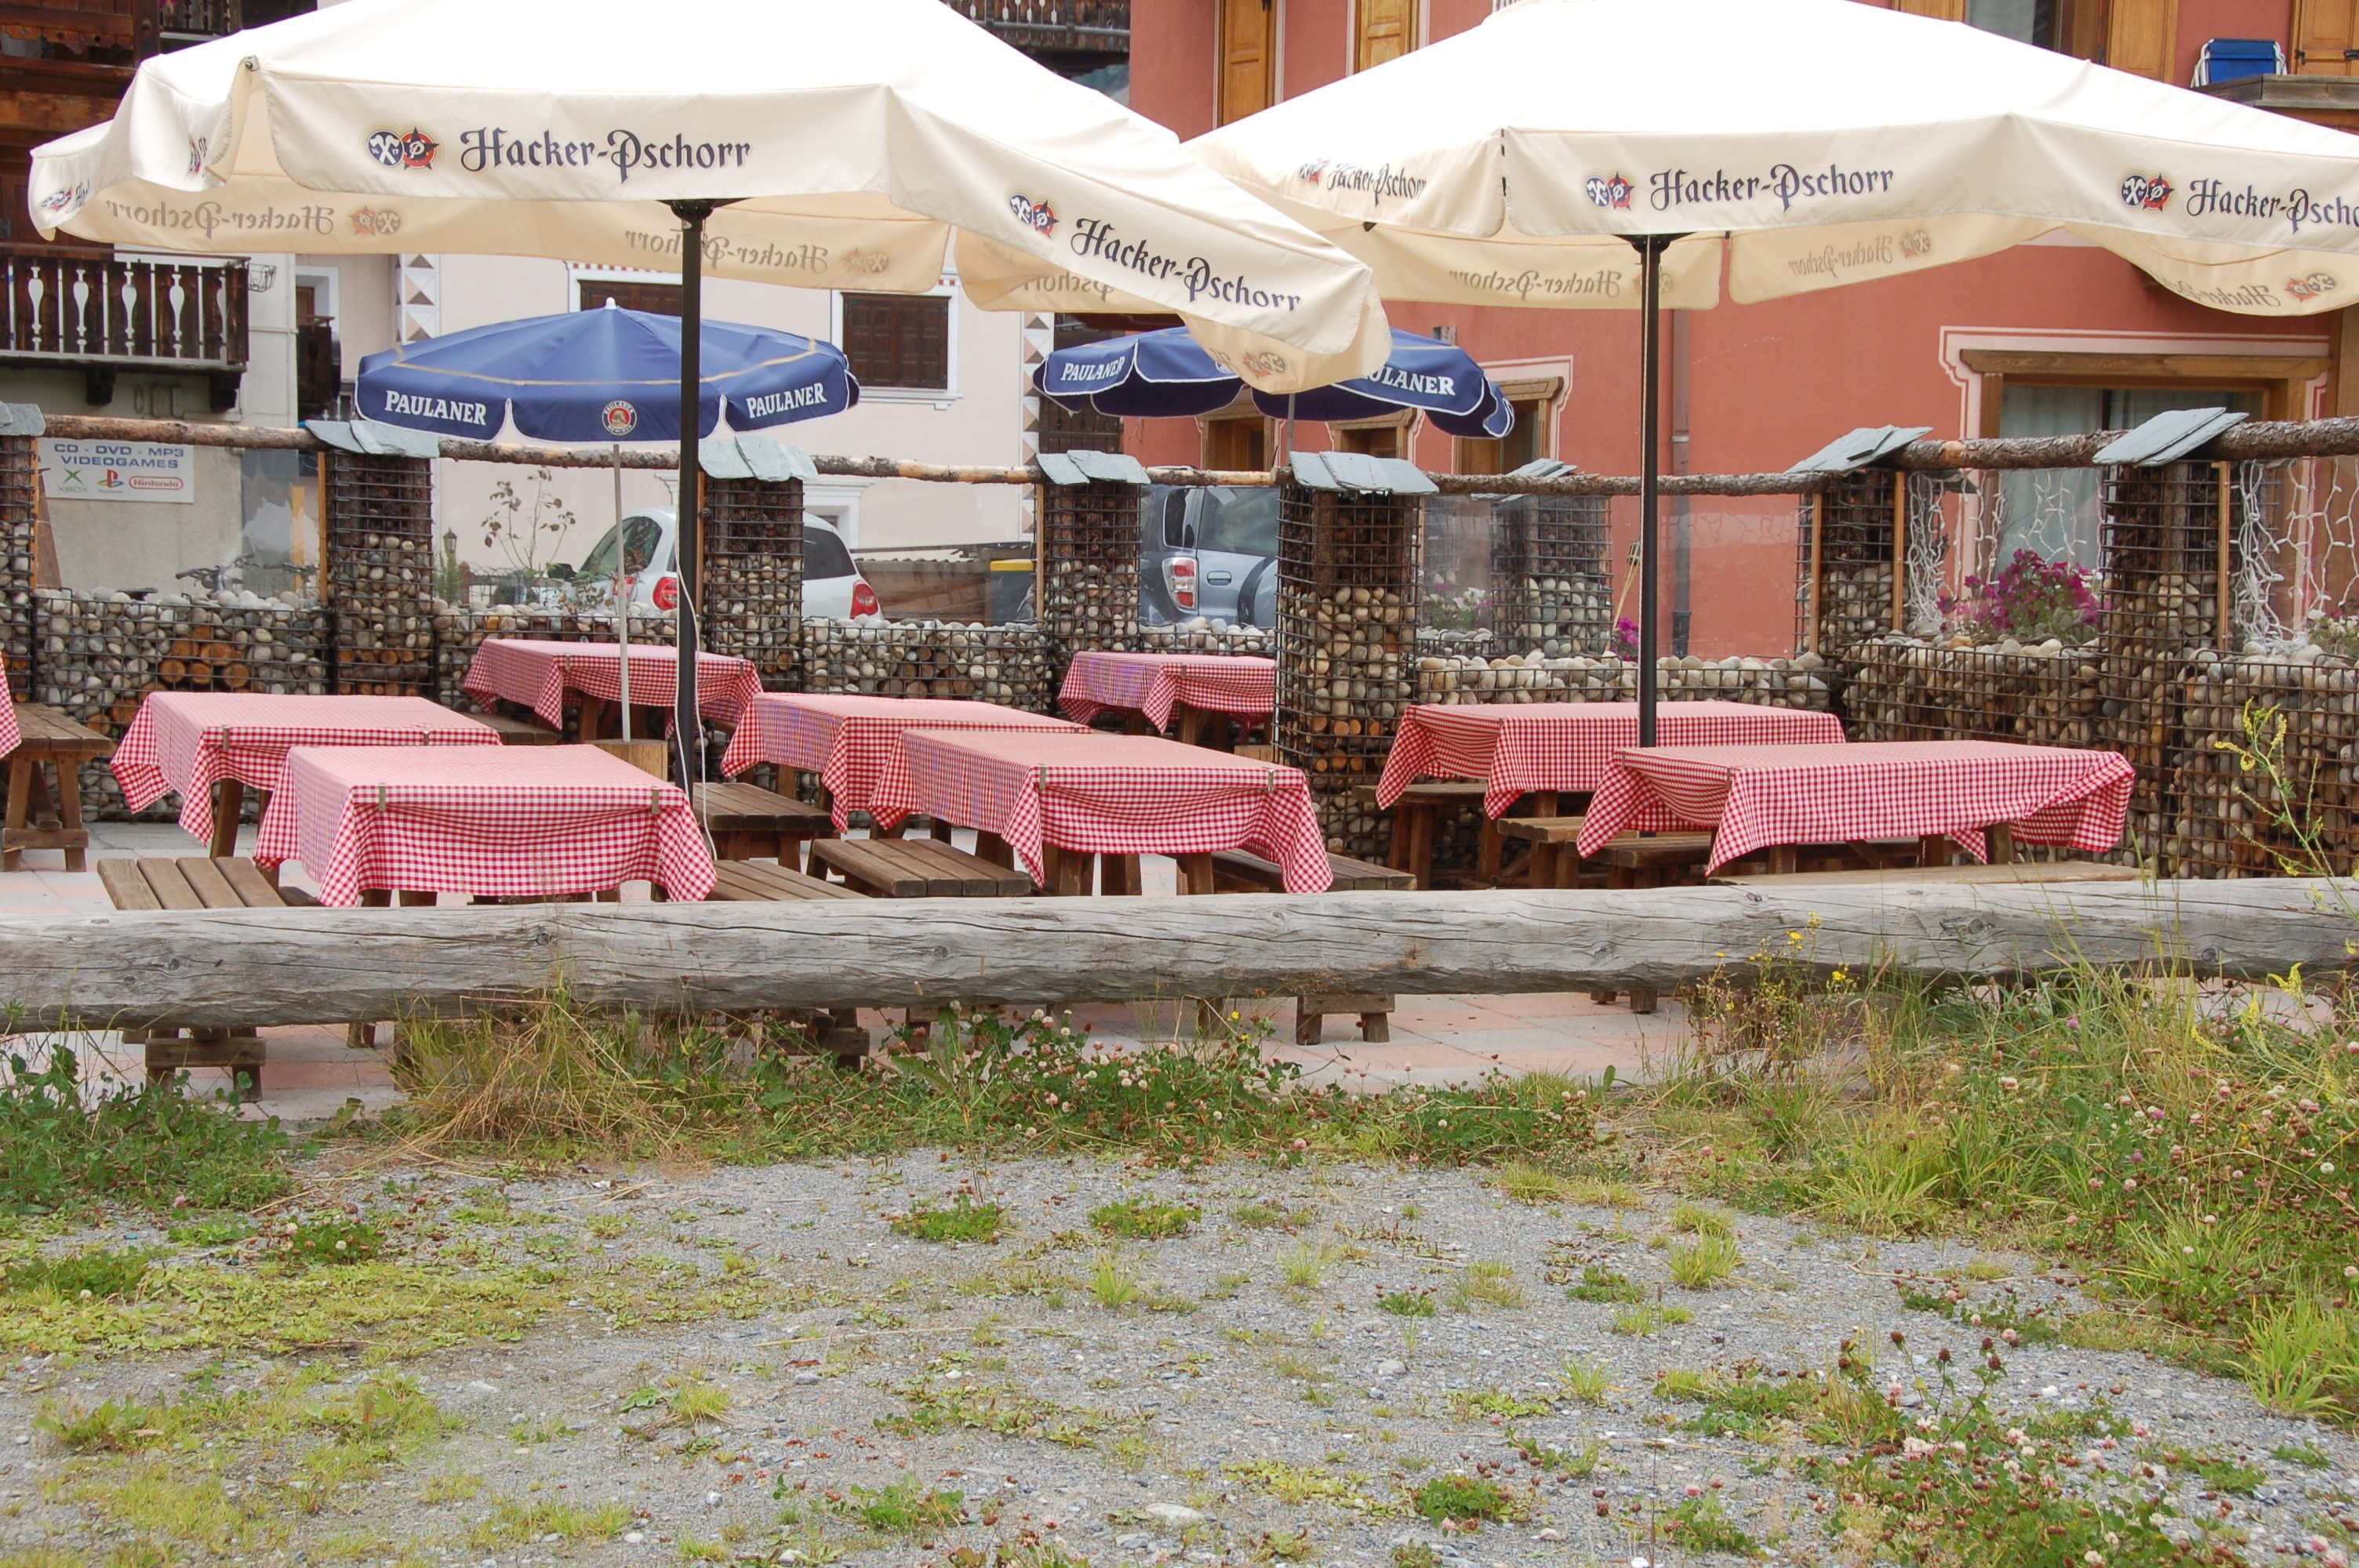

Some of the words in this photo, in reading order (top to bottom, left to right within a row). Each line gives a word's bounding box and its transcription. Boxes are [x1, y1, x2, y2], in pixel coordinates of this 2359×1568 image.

[460, 126, 752, 185] Hacker-Pschorr
[1650, 163, 1895, 213] Hacker-Pschorr
[1070, 217, 1302, 313] Hacker-Pschorr
[1060, 356, 1125, 381] PAULANER
[1367, 365, 1456, 396] ULANER
[384, 390, 487, 426] PAULANER
[745, 382, 827, 419] PAULANER
[54, 443, 78, 453] CD
[96, 445, 132, 455] DVD
[148, 447, 184, 457] MP3
[60, 455, 179, 469] VIDEOGAMES
